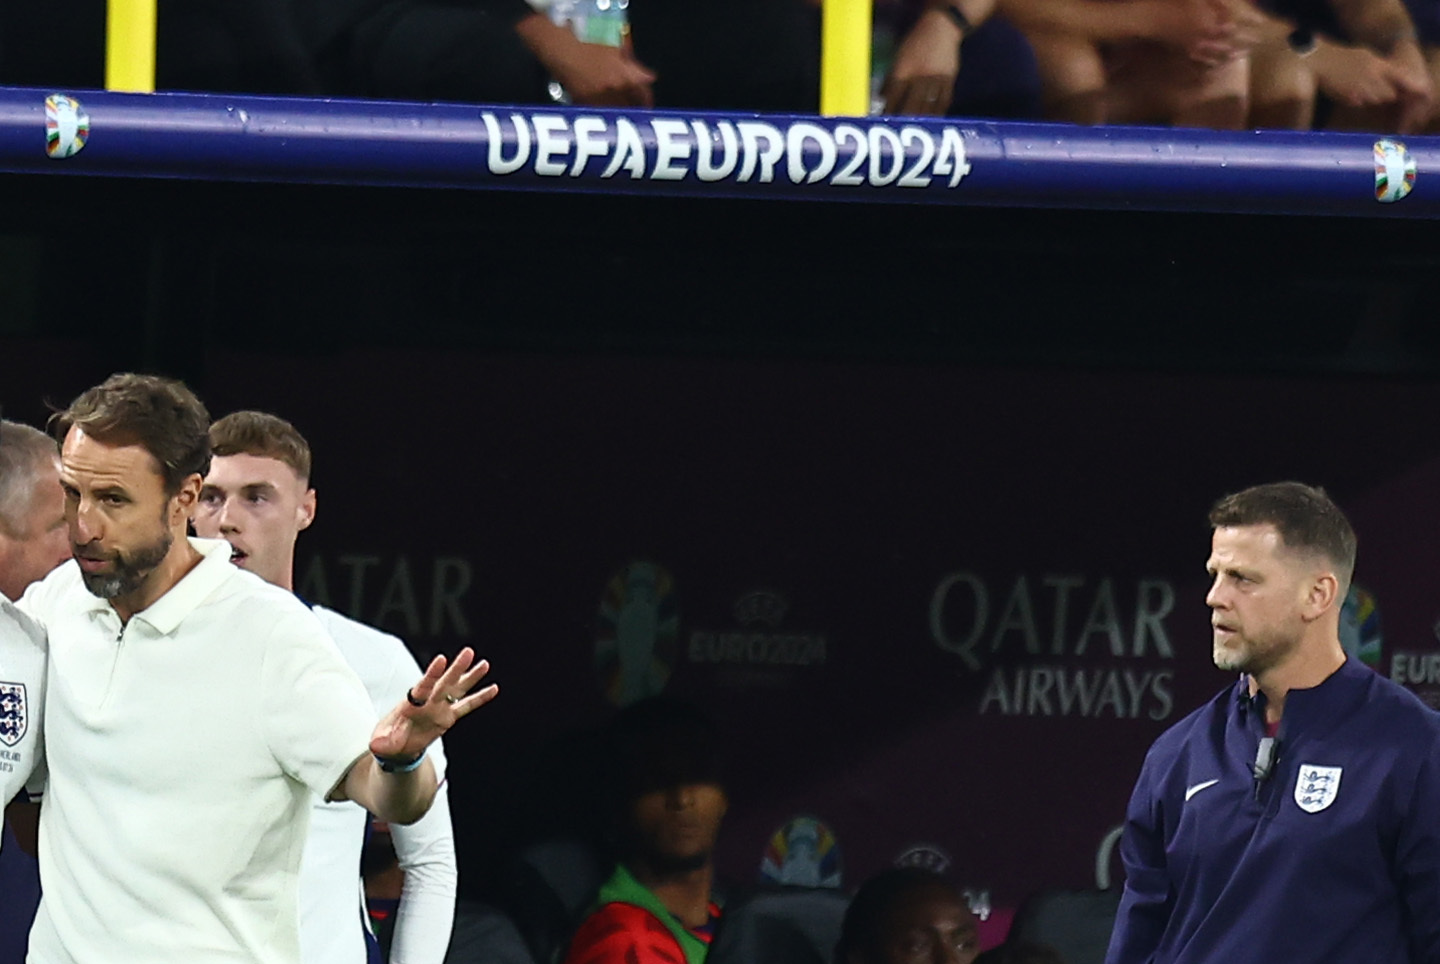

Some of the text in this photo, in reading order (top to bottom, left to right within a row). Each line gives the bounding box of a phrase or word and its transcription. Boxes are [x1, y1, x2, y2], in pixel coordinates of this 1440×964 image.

[302, 553, 474, 637] ATAR
[928, 571, 1177, 671] QATAR
[689, 631, 827, 666] EURO2024
[978, 665, 1175, 721] AIRWAYS
